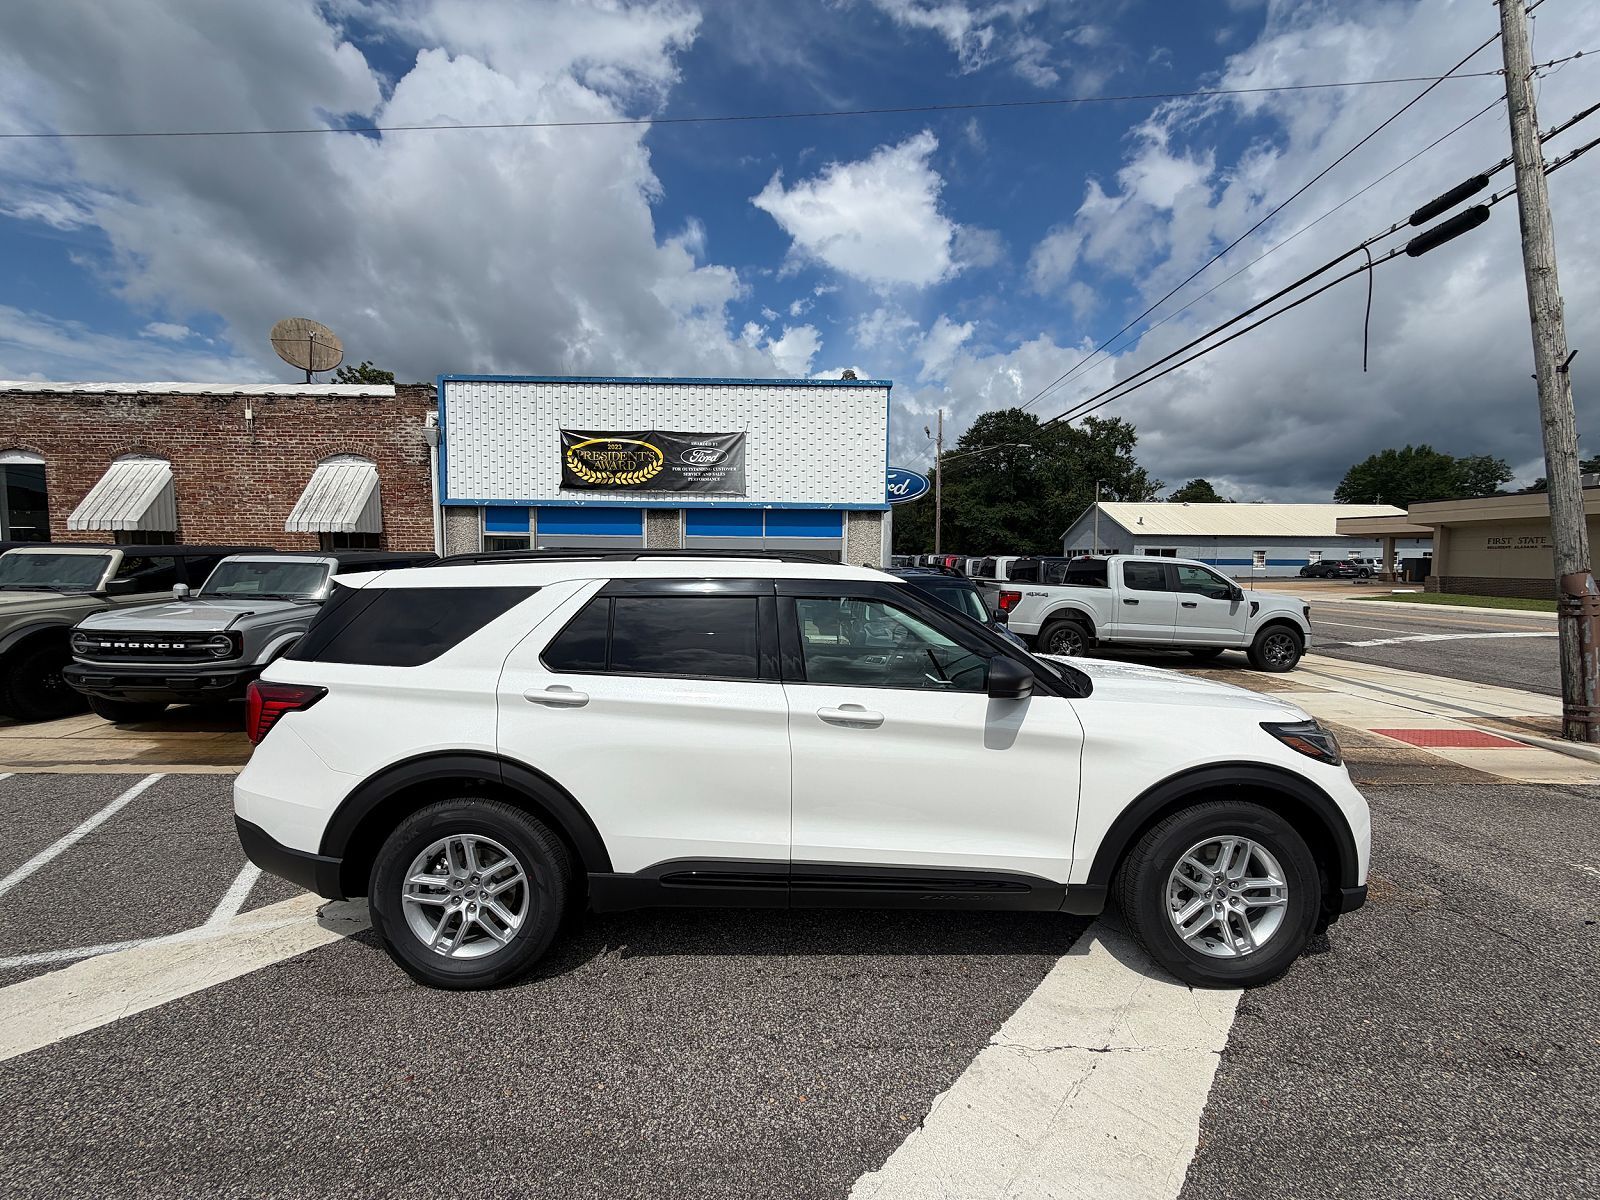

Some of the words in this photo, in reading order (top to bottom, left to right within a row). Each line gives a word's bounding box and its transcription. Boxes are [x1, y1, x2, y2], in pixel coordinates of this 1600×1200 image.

[576, 449, 656, 462] PRESIDENT'S
[690, 450, 720, 463] Ford
[593, 460, 637, 471] AWARD
[888, 474, 911, 495] rd
[1487, 537, 1513, 545] FIRST
[1518, 536, 1547, 544] STATE
